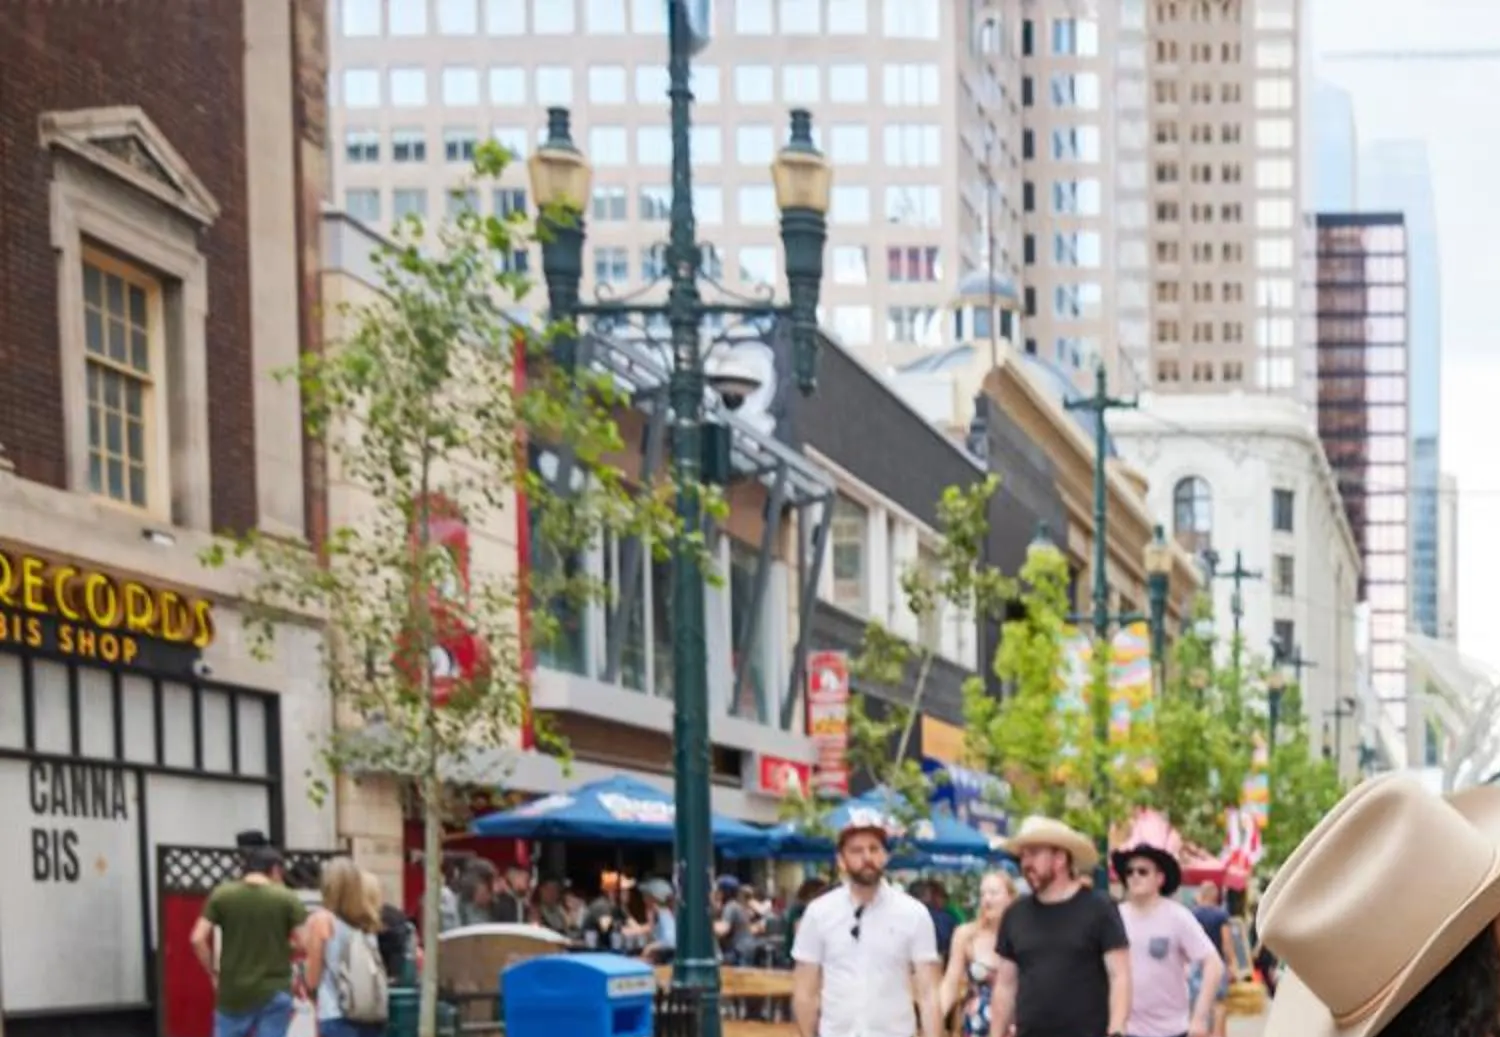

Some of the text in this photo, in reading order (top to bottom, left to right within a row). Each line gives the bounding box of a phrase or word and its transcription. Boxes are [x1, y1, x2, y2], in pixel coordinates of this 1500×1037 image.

[58, 622, 138, 665] SHOP
[29, 761, 127, 820] CANNA
[31, 827, 80, 883] BIS
